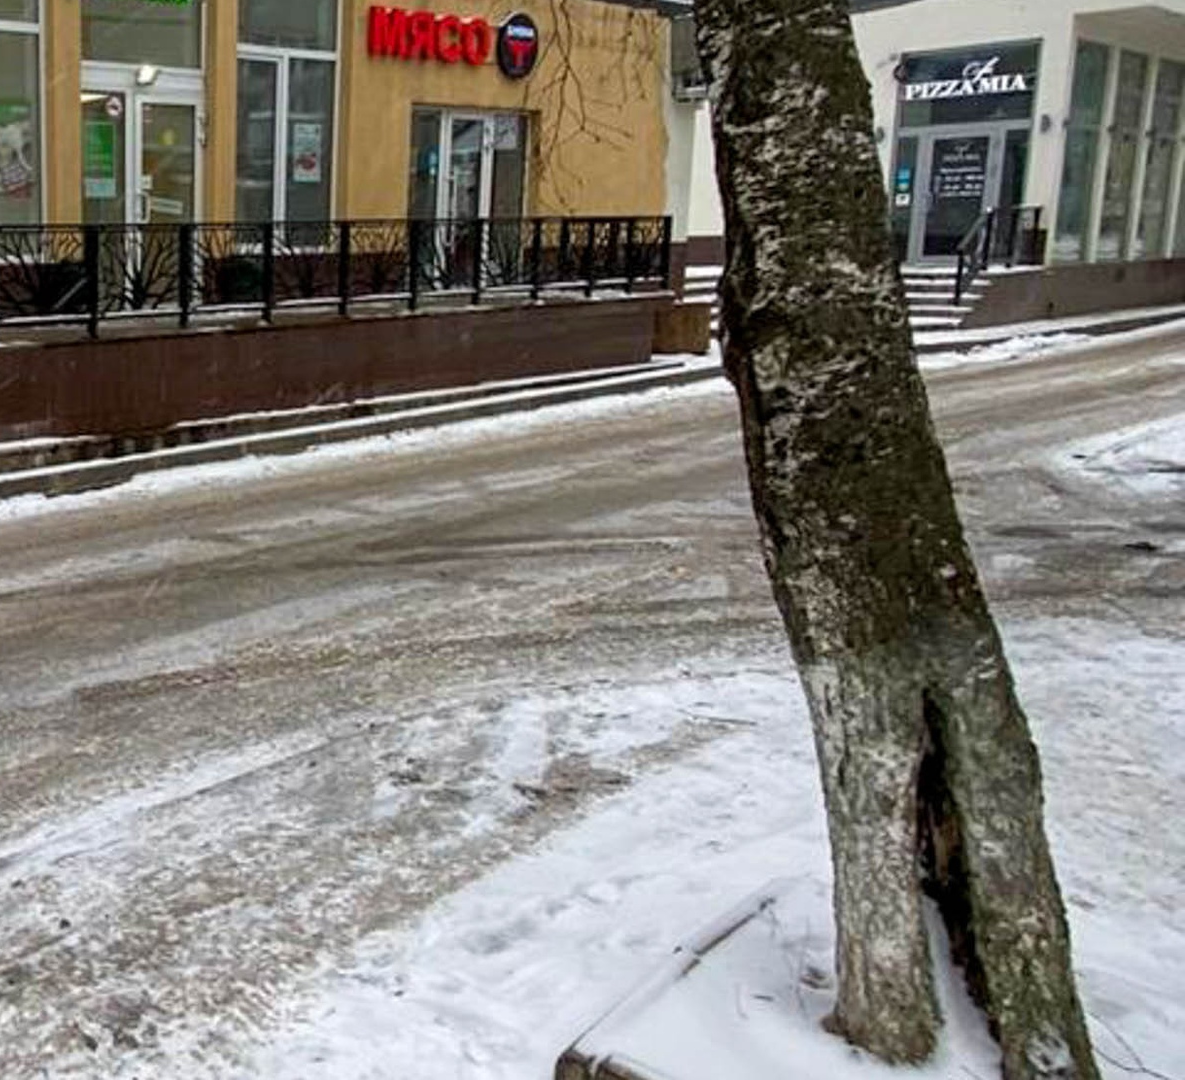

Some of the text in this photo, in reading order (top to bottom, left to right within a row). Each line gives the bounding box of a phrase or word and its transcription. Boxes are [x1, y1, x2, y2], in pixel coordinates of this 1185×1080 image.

[368, 5, 490, 66] МЯСО
[905, 73, 1026, 100] PIZZA MIA
